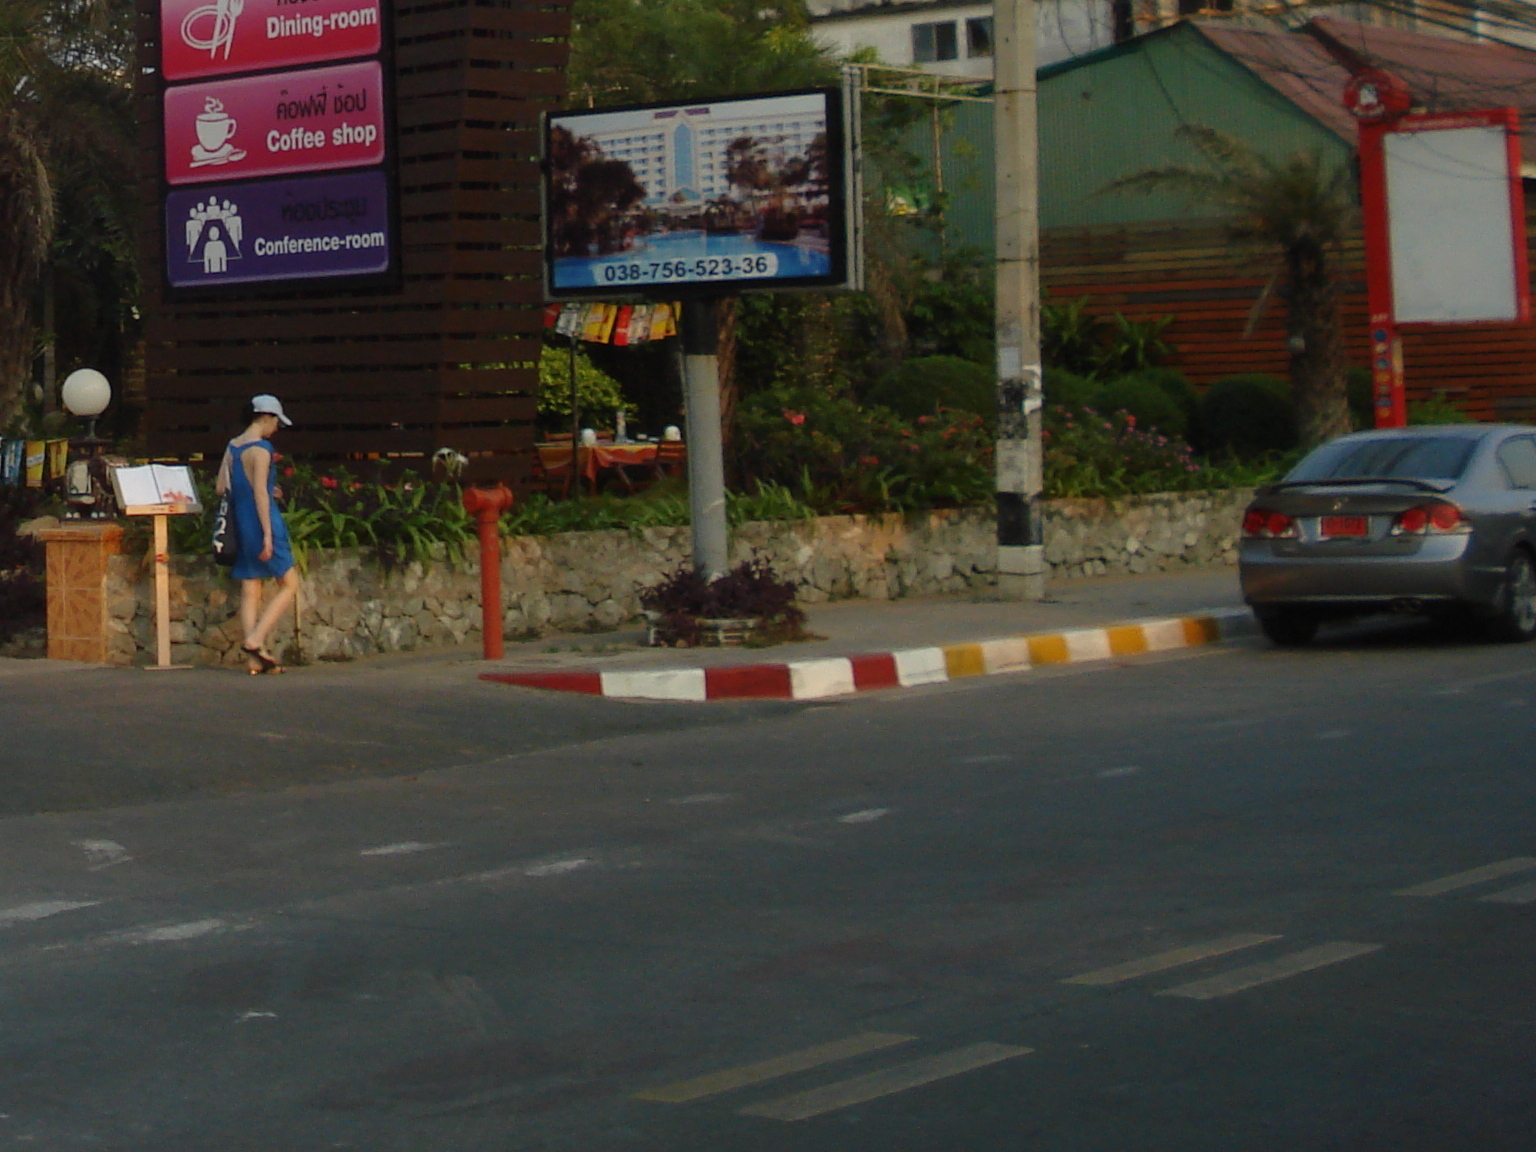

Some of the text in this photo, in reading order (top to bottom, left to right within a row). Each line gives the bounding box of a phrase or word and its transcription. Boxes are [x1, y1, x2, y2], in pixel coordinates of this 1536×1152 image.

[266, 7, 377, 39] Dining-room
[266, 122, 377, 152] Coffee shop
[254, 231, 385, 256] Conference-room
[604, 256, 768, 282] 038-756-523-36
